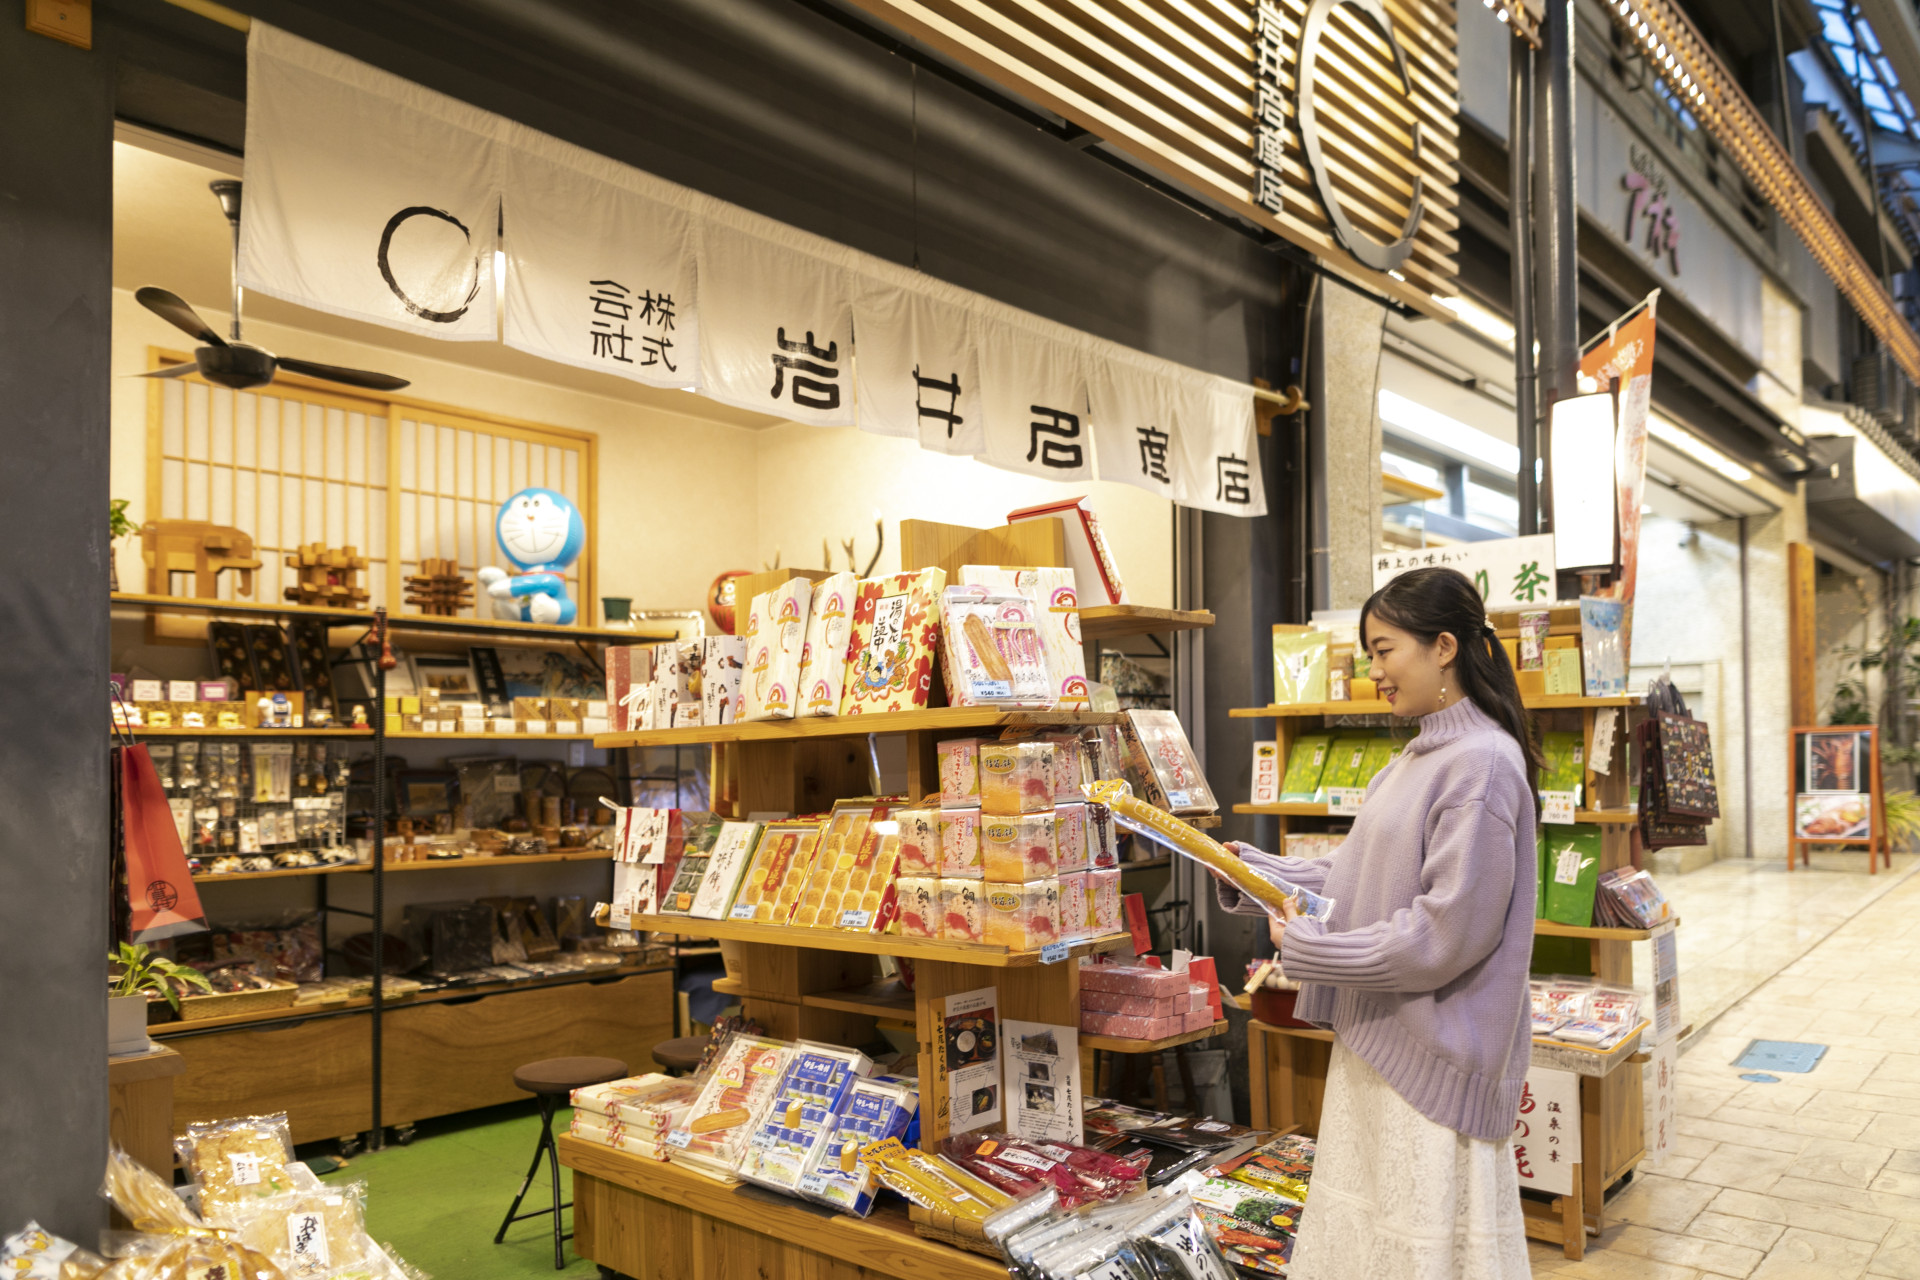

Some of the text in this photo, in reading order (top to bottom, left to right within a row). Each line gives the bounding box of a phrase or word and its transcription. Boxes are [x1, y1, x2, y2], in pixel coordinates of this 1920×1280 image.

[1377, 551, 1469, 571] 極上の味わい
[1547, 1100, 1562, 1164] 温泉の素
